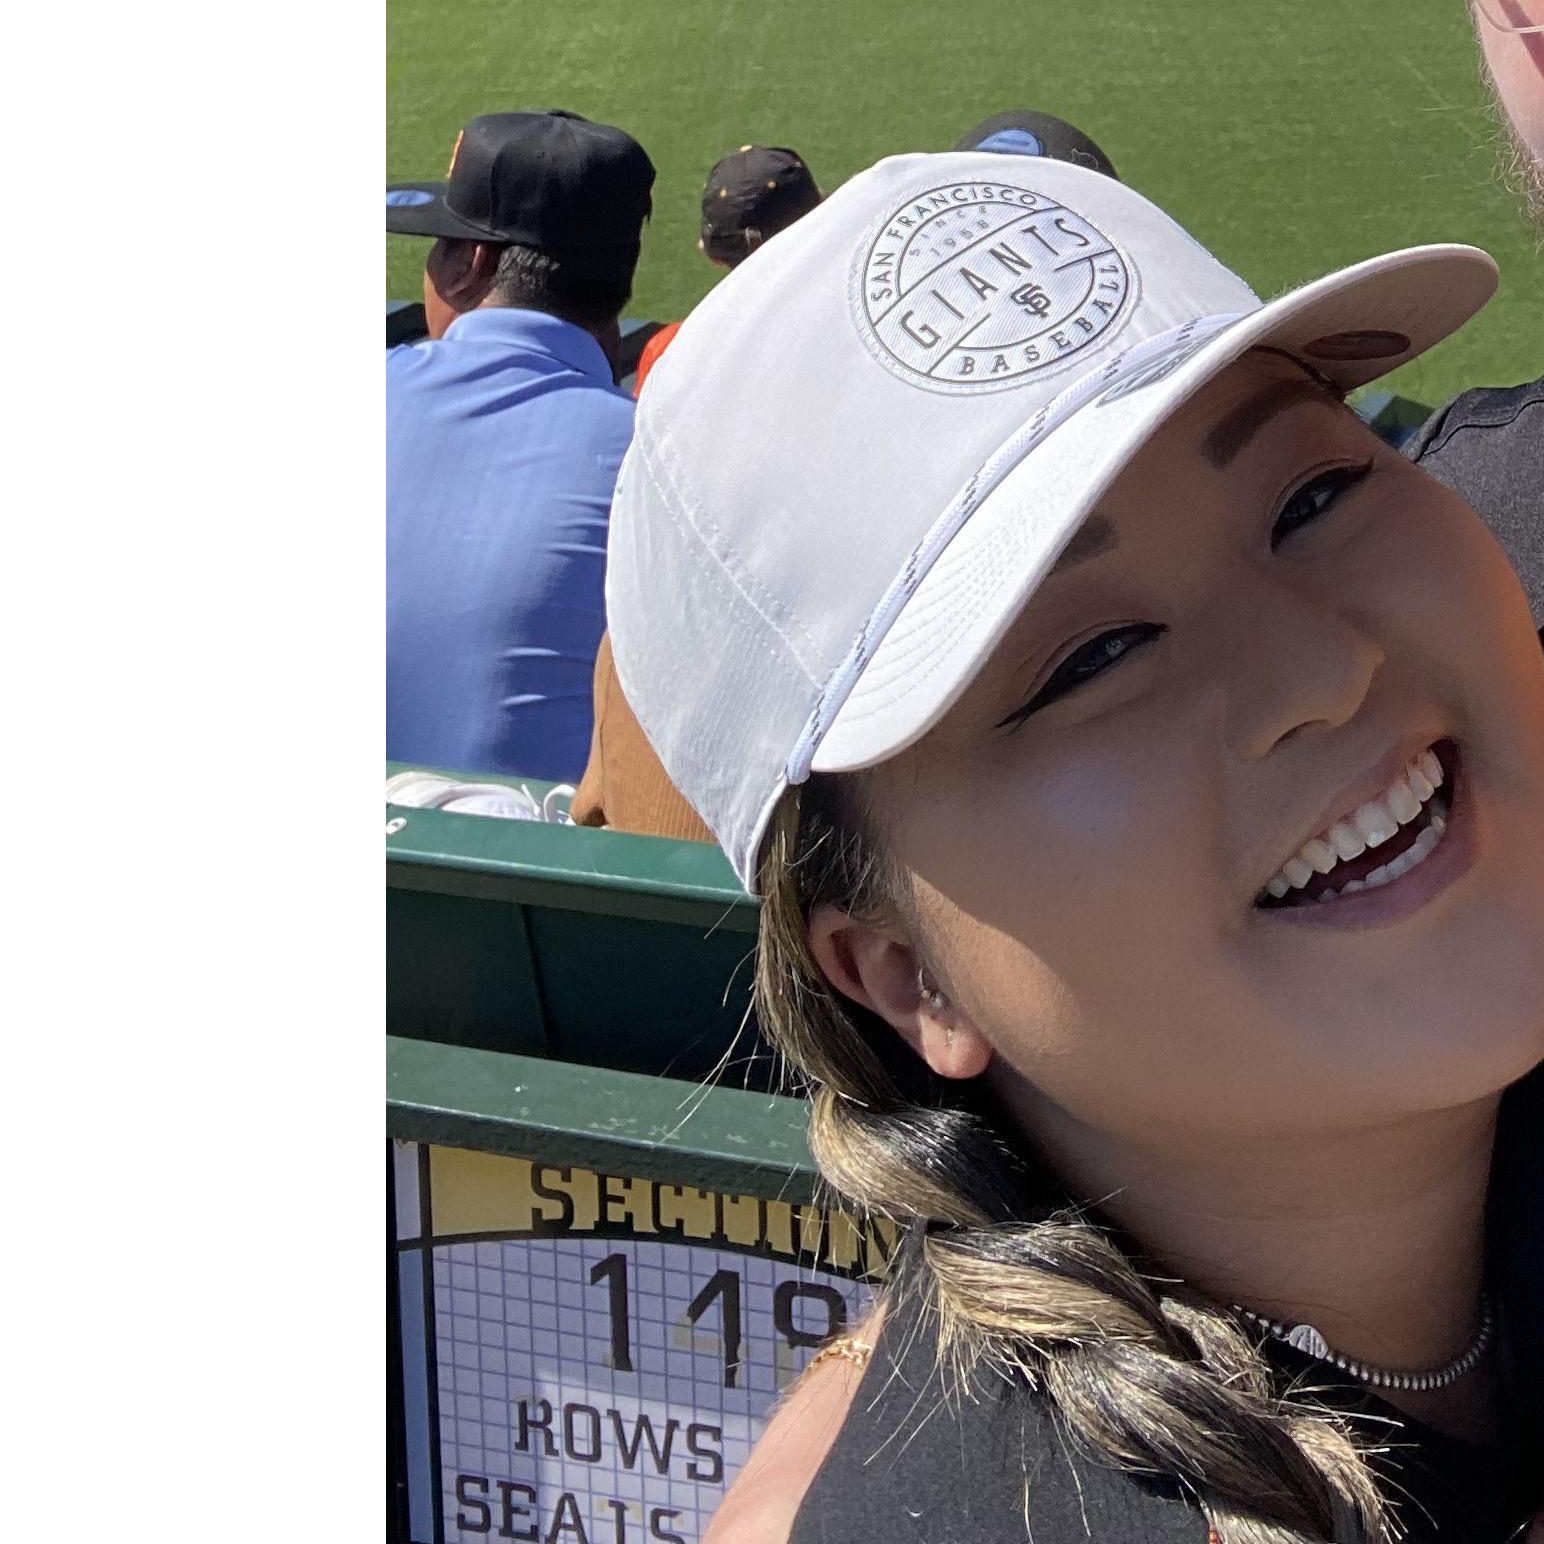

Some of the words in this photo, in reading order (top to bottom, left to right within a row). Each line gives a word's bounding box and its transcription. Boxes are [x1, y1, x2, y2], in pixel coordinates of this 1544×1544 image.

[871, 252, 896, 303] SAN
[888, 186, 1037, 240] FRANCISCO
[899, 217, 1090, 349] GIANTS
[959, 263, 1120, 376] BASEBALL
[515, 1398, 723, 1483] ROWS
